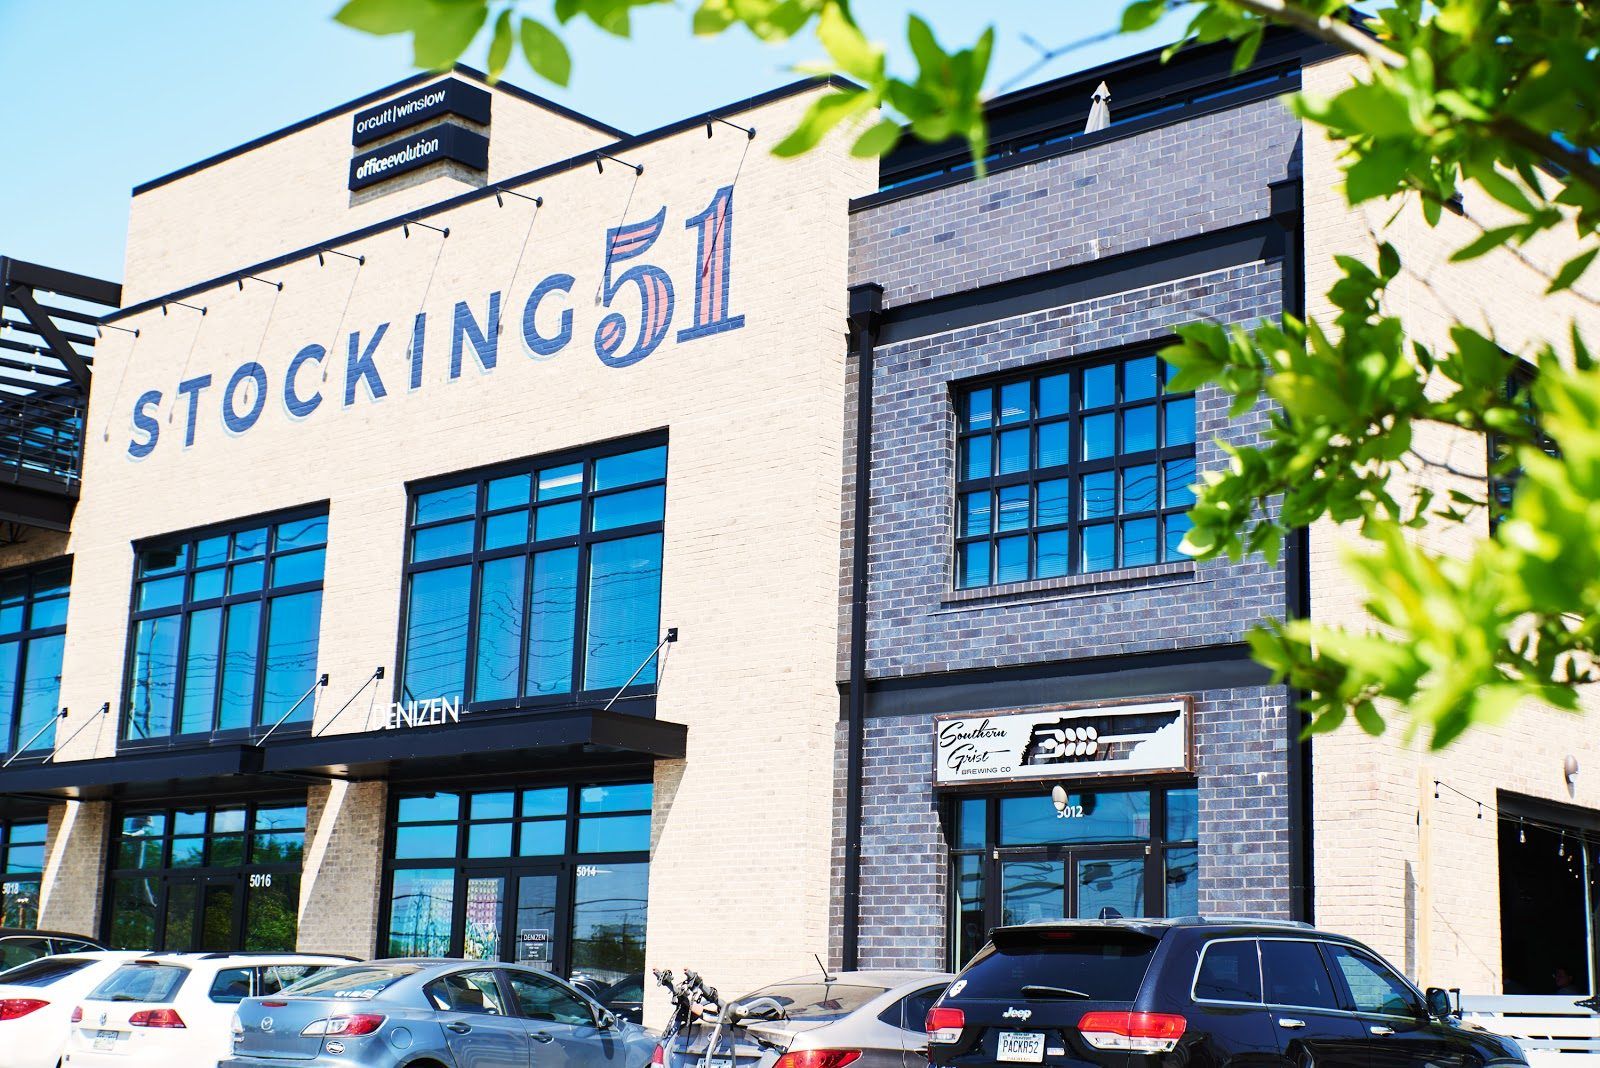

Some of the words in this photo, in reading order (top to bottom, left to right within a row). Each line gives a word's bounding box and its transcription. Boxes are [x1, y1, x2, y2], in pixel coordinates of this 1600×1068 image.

[356, 138, 439, 180] officeevolution
[127, 272, 577, 459] STOCKING
[594, 184, 746, 369] 51
[374, 695, 460, 731] DENIZEN
[939, 718, 1008, 748] Southern
[946, 743, 1011, 775] Grist
[961, 767, 998, 775] BREWING
[576, 866, 597, 877] 5014
[249, 874, 272, 888] 5016
[523, 933, 547, 942] DENIZEN
[1002, 1006, 1033, 1021] Jeep
[1002, 1039, 1040, 1054] PACKR52
